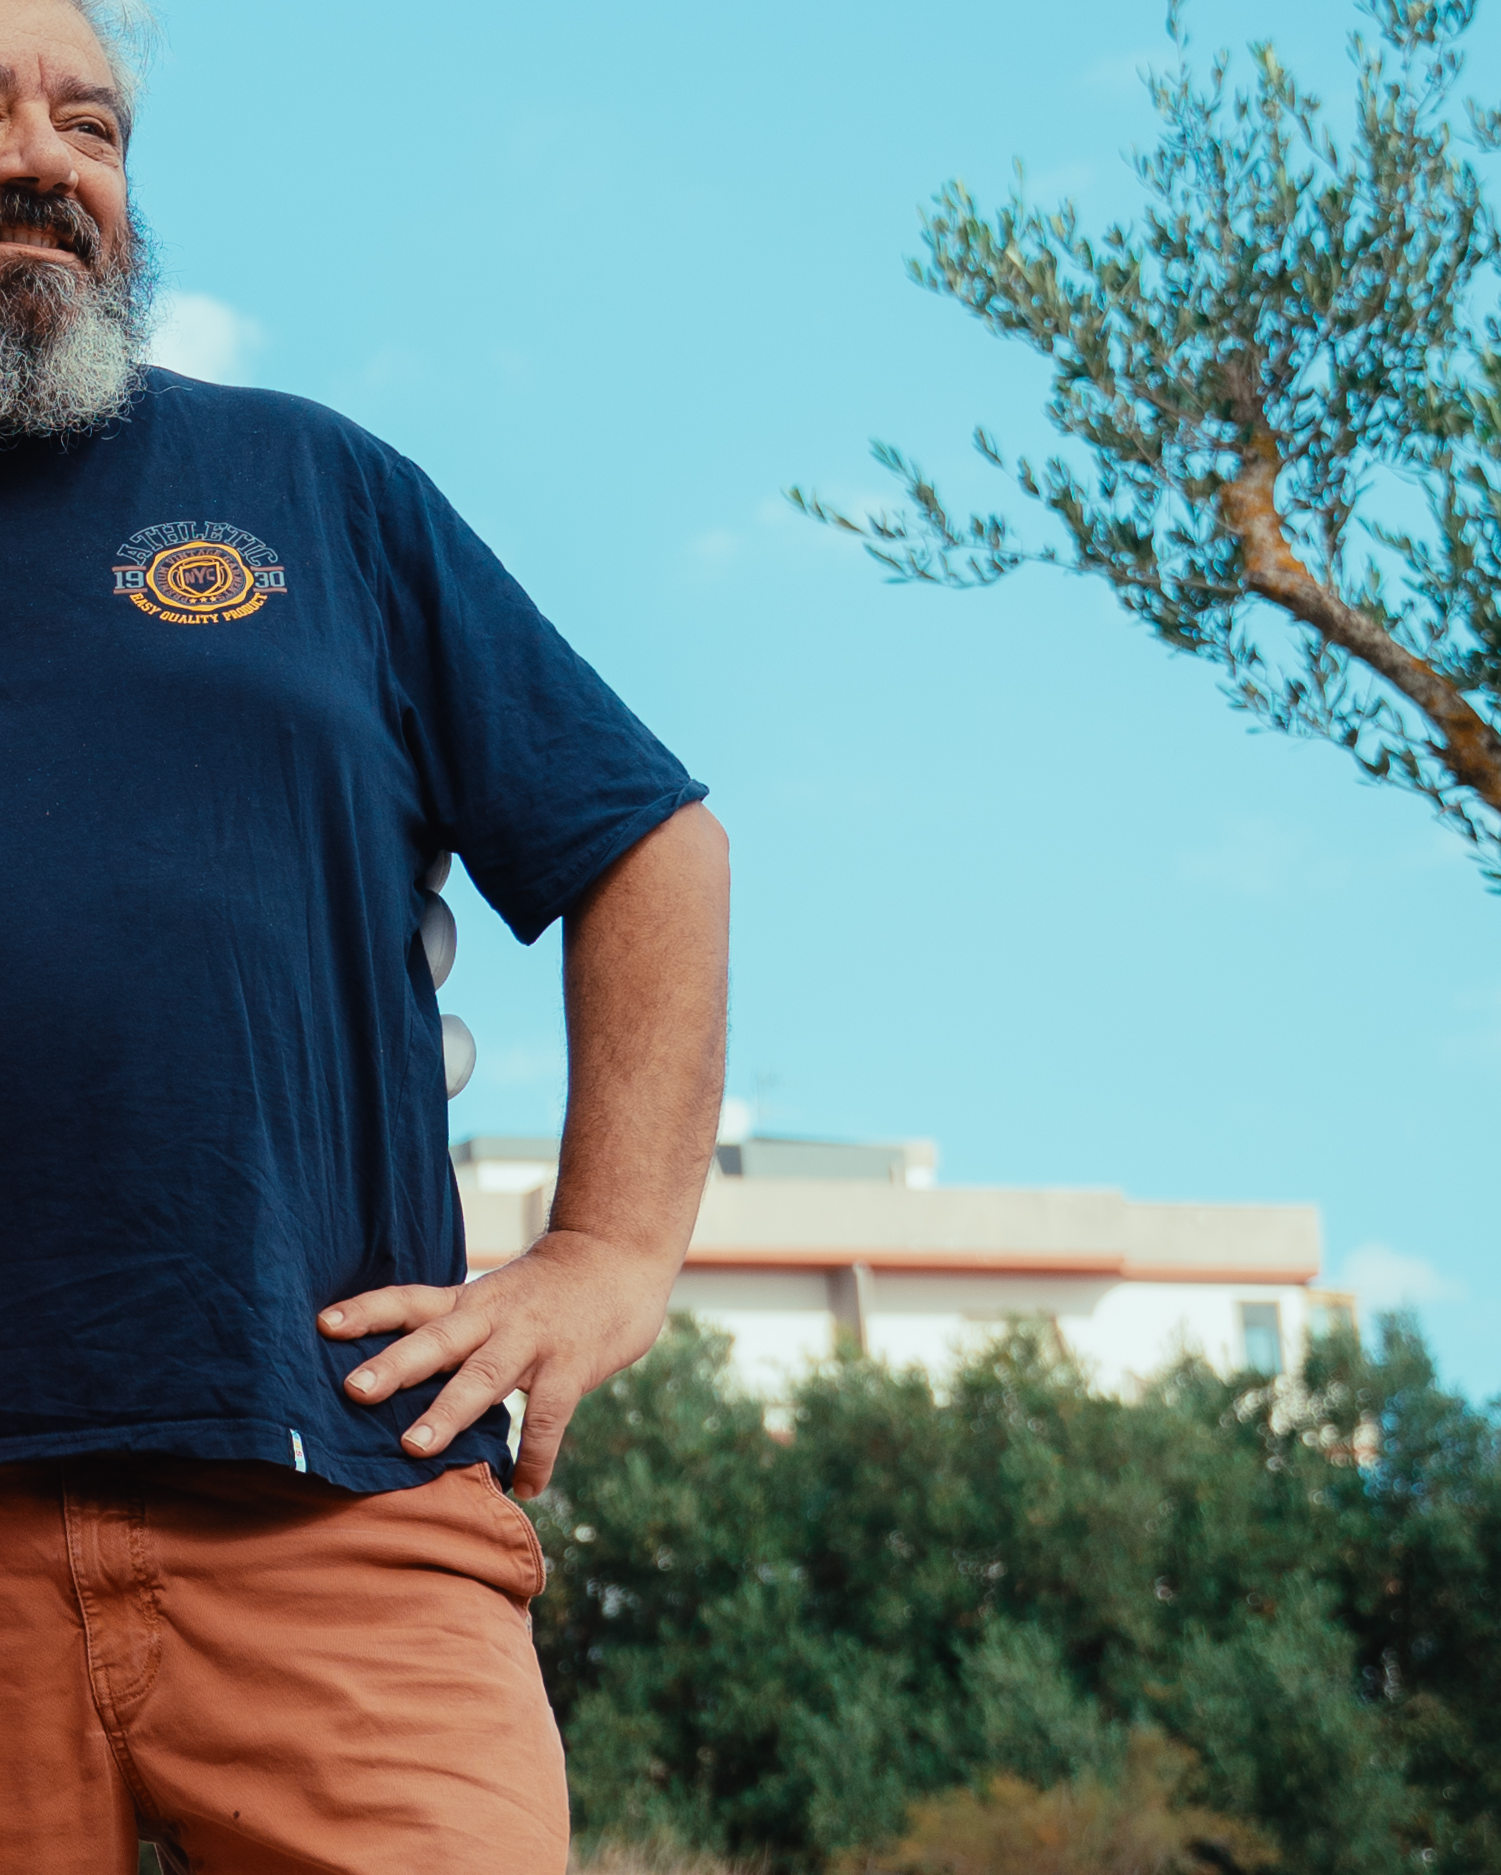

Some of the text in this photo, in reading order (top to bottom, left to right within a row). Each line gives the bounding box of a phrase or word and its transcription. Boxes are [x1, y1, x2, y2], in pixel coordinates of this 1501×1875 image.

[116, 520, 278, 566] ATHLETIC
[165, 549, 222, 565] VINTAGE
[113, 570, 145, 589] 19
[184, 566, 216, 584] NYC
[253, 570, 286, 589] 30
[129, 592, 269, 624] EASY QUALITY PRODUCT
